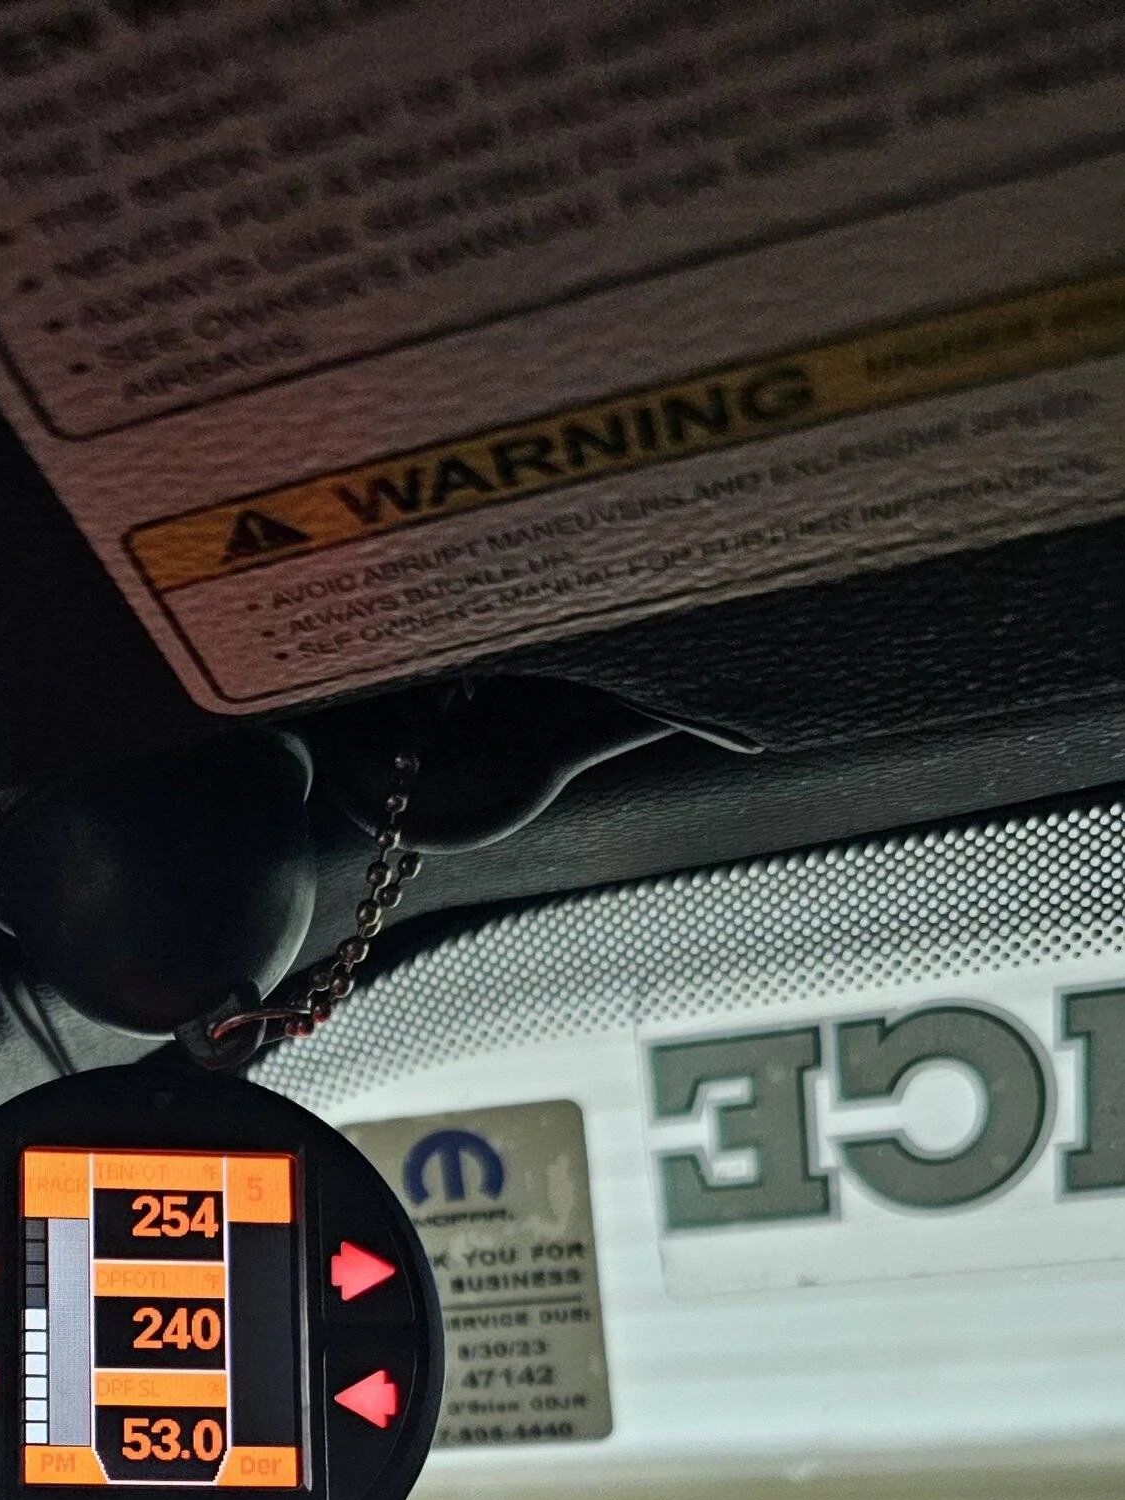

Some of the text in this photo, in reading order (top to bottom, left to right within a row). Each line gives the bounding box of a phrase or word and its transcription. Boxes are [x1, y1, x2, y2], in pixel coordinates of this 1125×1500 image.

[335, 367, 813, 525] WARNING
[271, 572, 358, 611] AVOID
[362, 539, 481, 588] ABRUPT
[486, 491, 687, 553] MANEUVERS
[694, 471, 762, 501] AND
[289, 593, 401, 635] ALWAYS
[403, 568, 522, 606] BUCKLE
[247, 1176, 263, 1200] 5
[132, 1195, 219, 1238] 254
[462, 1246, 516, 1266] YOU
[531, 1241, 585, 1262] FOR
[450, 1268, 581, 1294] BUSINESS
[133, 1307, 221, 1350] 240
[461, 1364, 553, 1389] 47142
[122, 1417, 223, 1461] 53.0
[40, 1454, 75, 1474] PM
[240, 1455, 283, 1476] Der
